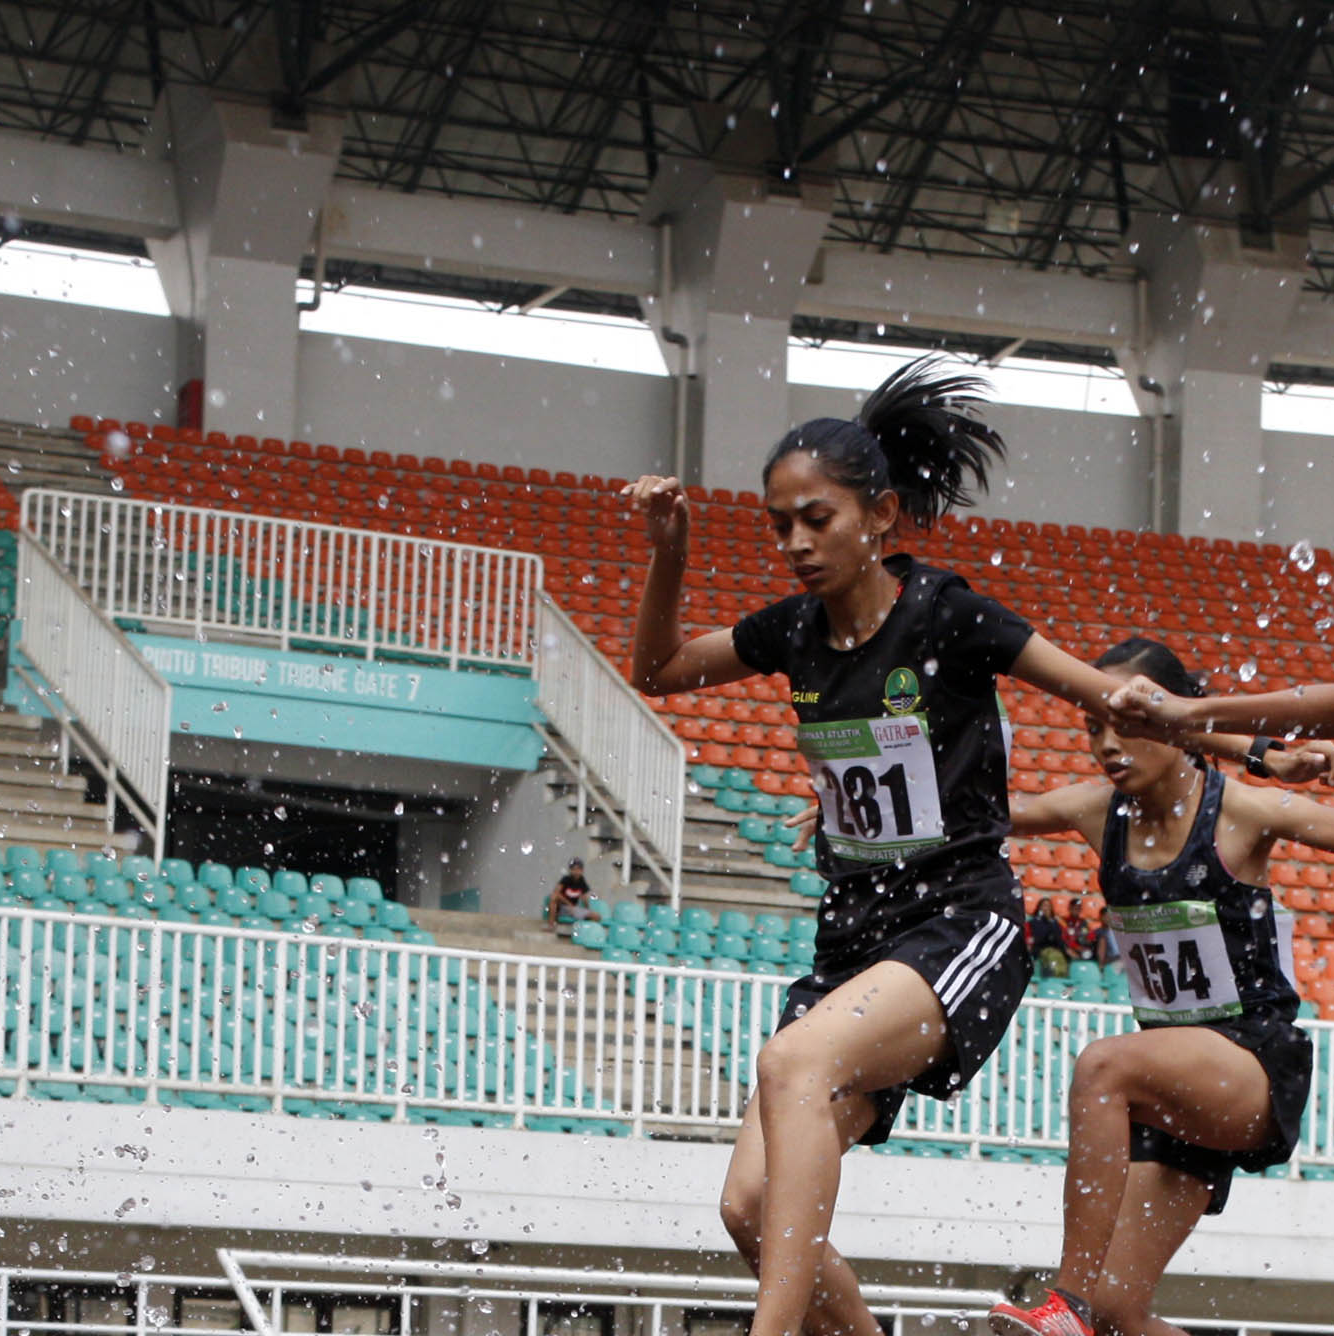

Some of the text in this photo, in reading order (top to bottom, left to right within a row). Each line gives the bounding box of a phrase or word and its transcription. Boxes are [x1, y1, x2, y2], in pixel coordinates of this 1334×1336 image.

[202, 651, 267, 682] TRIBUN
[277, 660, 349, 693] TRIBUNE
[354, 670, 399, 699] GATE
[406, 673, 422, 701] 7
[821, 764, 914, 839] 281
[1128, 939, 1211, 1005] 154
